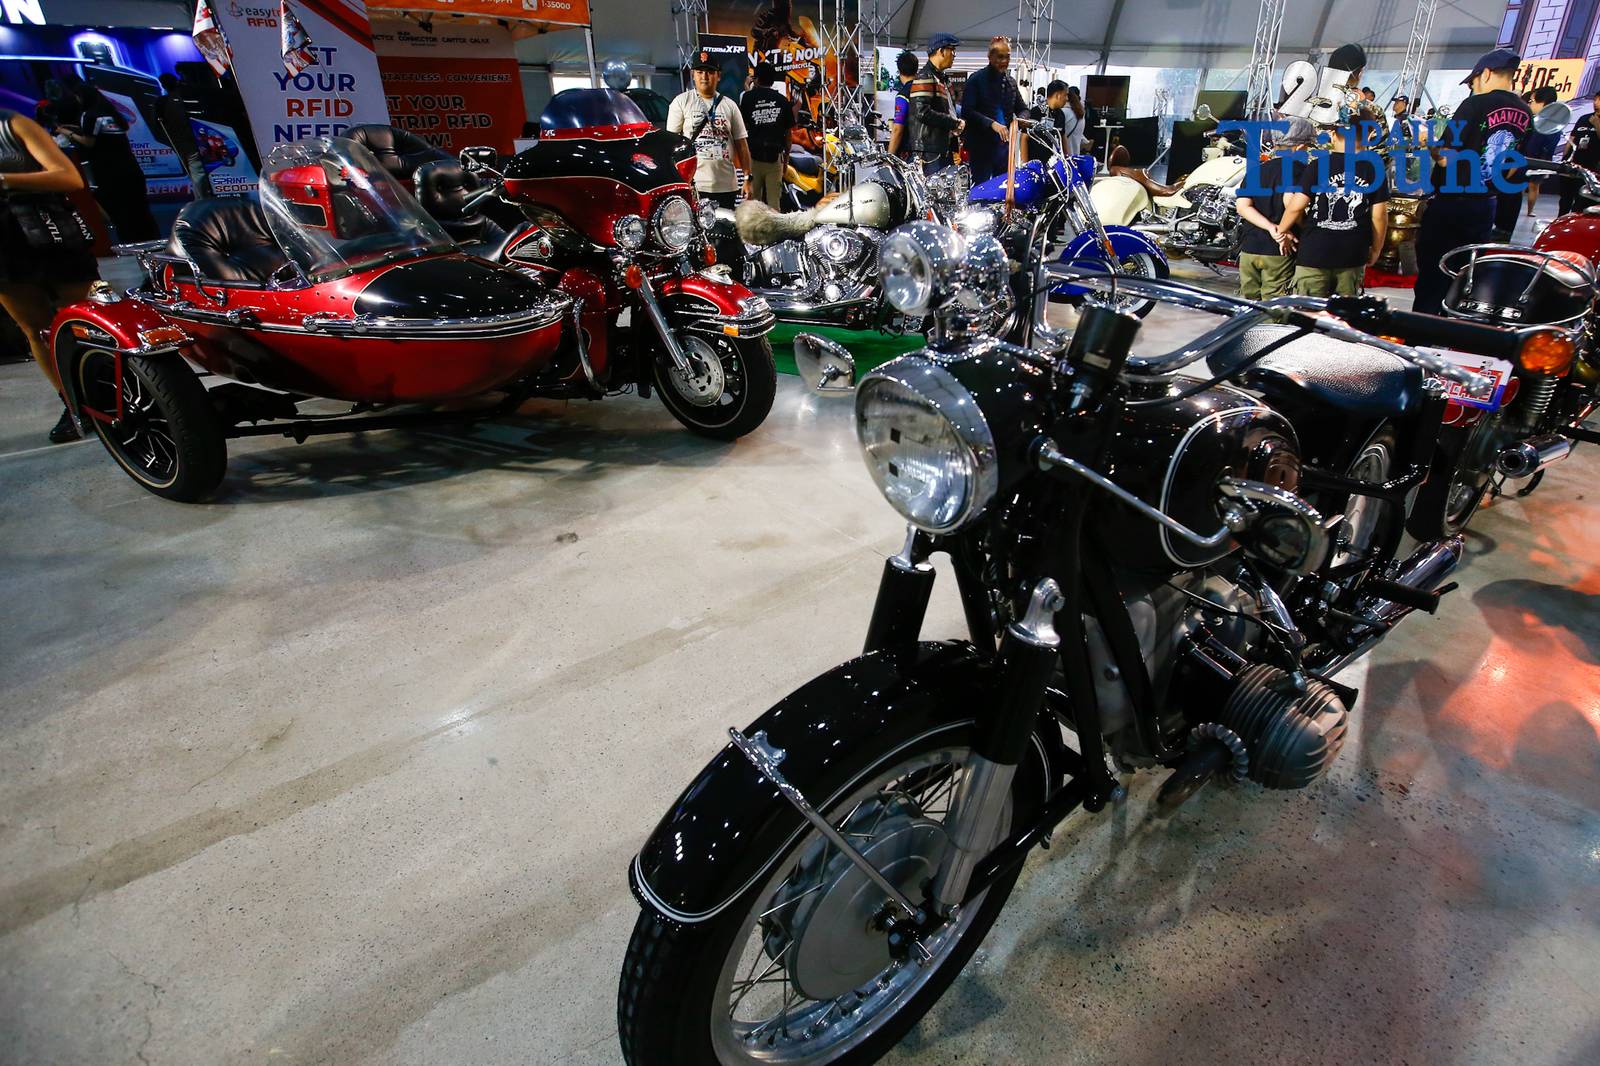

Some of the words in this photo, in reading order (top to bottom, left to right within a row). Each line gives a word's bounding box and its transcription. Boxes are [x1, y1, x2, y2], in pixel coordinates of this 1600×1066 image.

[247, 18, 277, 27] RFID
[783, 50, 792, 63] is
[273, 72, 355, 91] YOUR
[287, 98, 353, 117] RFID
[407, 96, 464, 110] YOUR
[752, 107, 781, 117] SILENCE
[447, 115, 492, 128] RFID
[1488, 109, 1530, 129] MANILA
[213, 177, 247, 185] SPRINT
